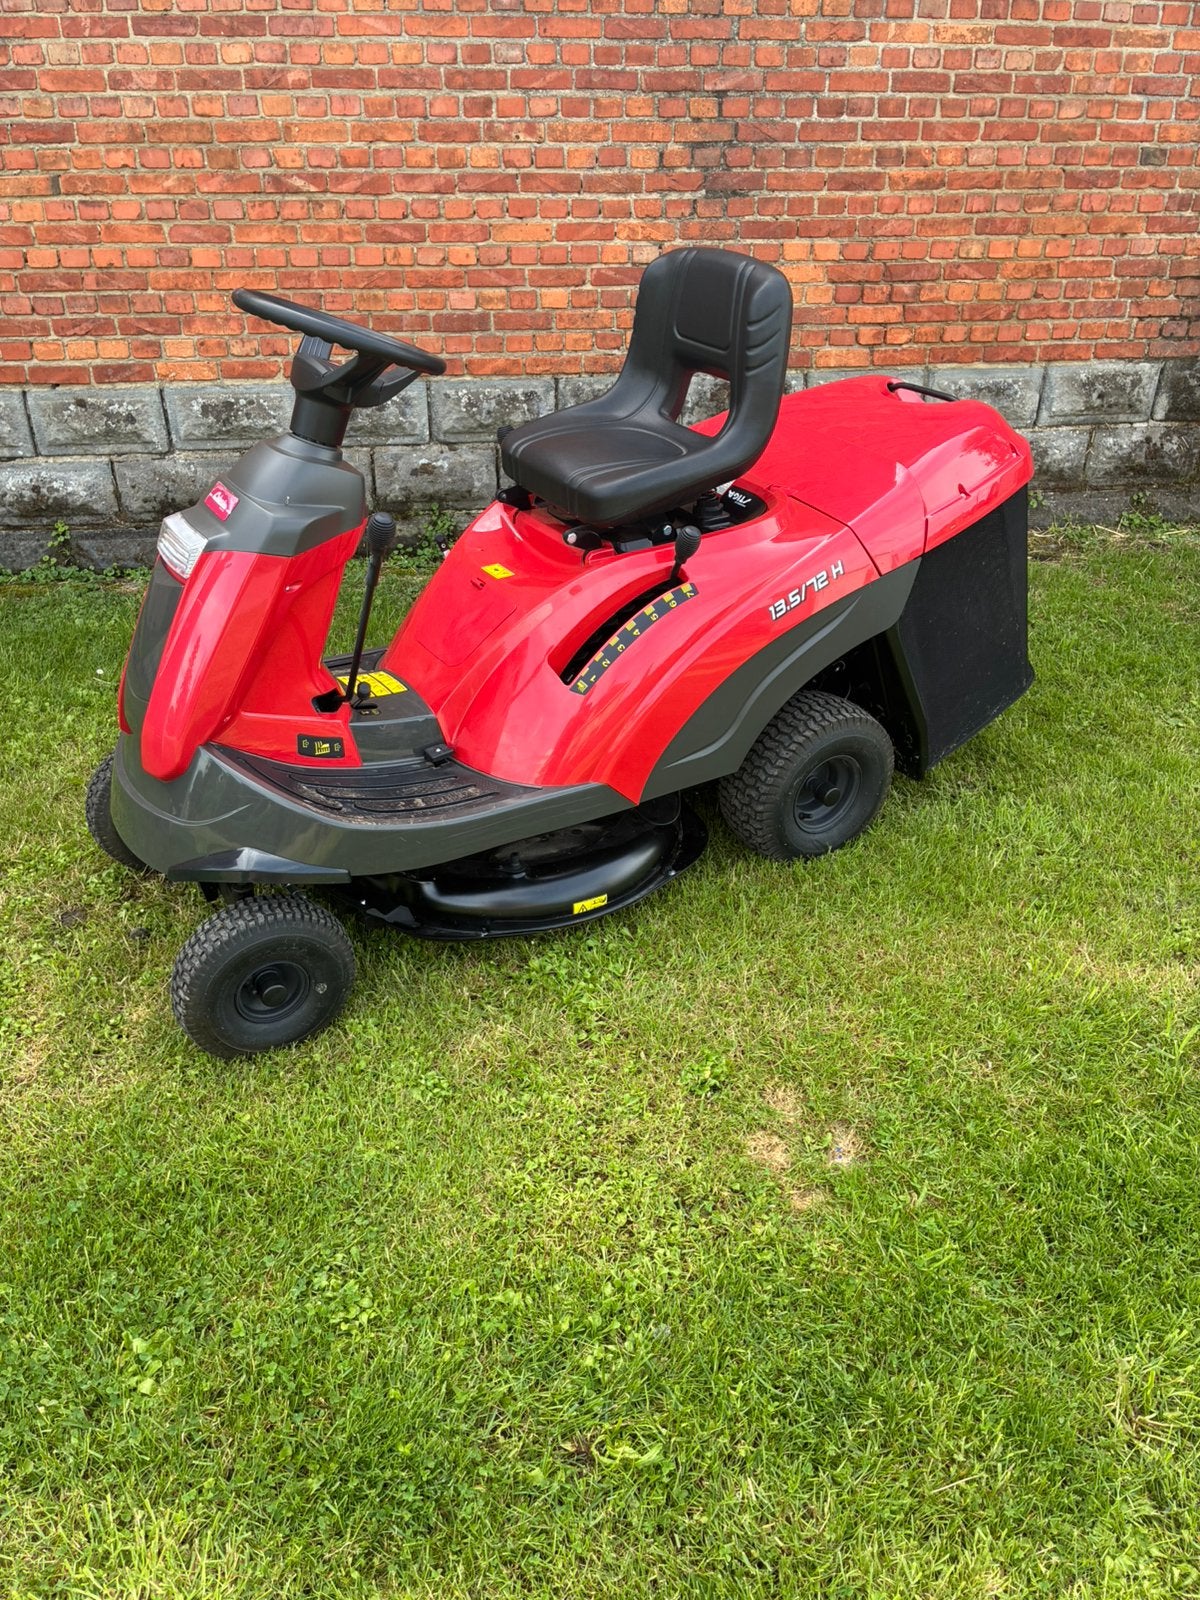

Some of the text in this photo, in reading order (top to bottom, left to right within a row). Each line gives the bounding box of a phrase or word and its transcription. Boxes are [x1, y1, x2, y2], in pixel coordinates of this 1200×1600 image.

[686, 589, 695, 598] 7
[768, 559, 844, 620] 13.5/72 H
[668, 600, 678, 608] 6
[650, 613, 659, 621] 5
[632, 628, 641, 636] 4
[616, 643, 626, 653] 3
[601, 658, 611, 668] 2
[589, 674, 597, 683] 1
